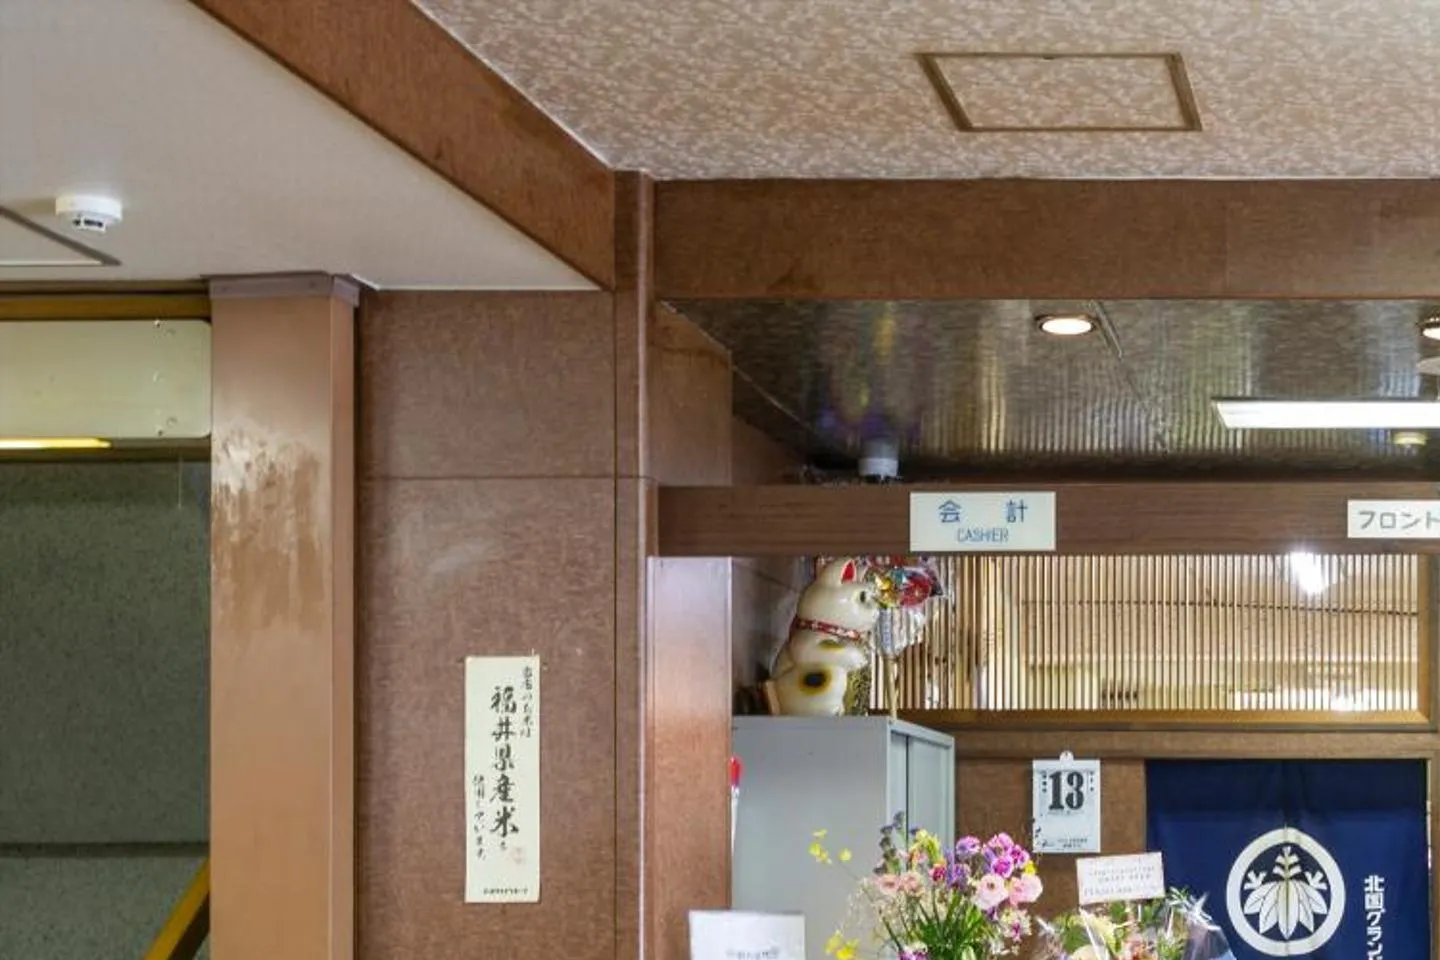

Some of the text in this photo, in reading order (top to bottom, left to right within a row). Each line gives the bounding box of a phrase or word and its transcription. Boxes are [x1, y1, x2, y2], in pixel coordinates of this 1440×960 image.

[938, 499, 1028, 523] 会計
[1358, 511, 1440, 530] フロント
[957, 527, 1009, 542] CASHIER
[1048, 771, 1085, 811] 13
